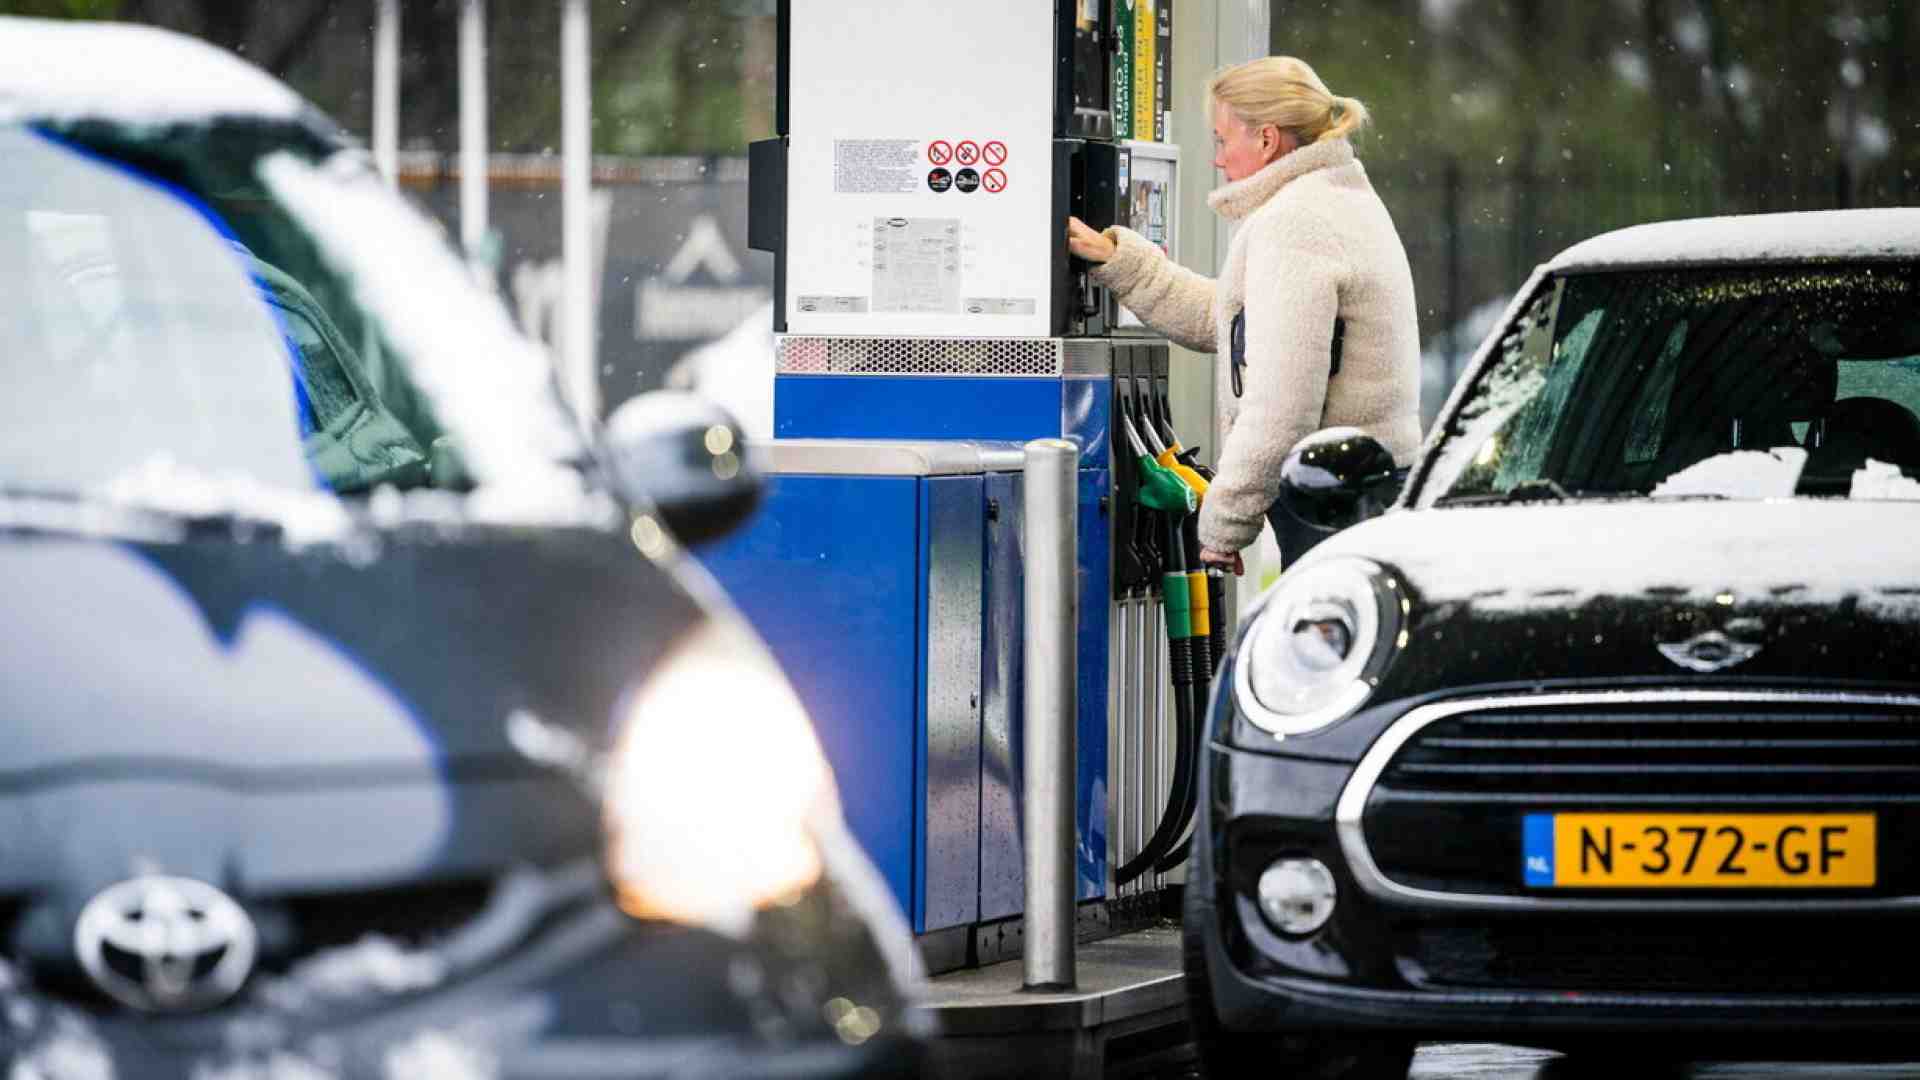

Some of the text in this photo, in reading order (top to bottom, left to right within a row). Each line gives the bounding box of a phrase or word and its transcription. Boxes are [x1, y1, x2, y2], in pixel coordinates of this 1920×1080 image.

[1116, 67, 1124, 136] EURO
[1155, 53, 1164, 139] DIESEL
[1579, 826, 1849, 875] N-372-GF
